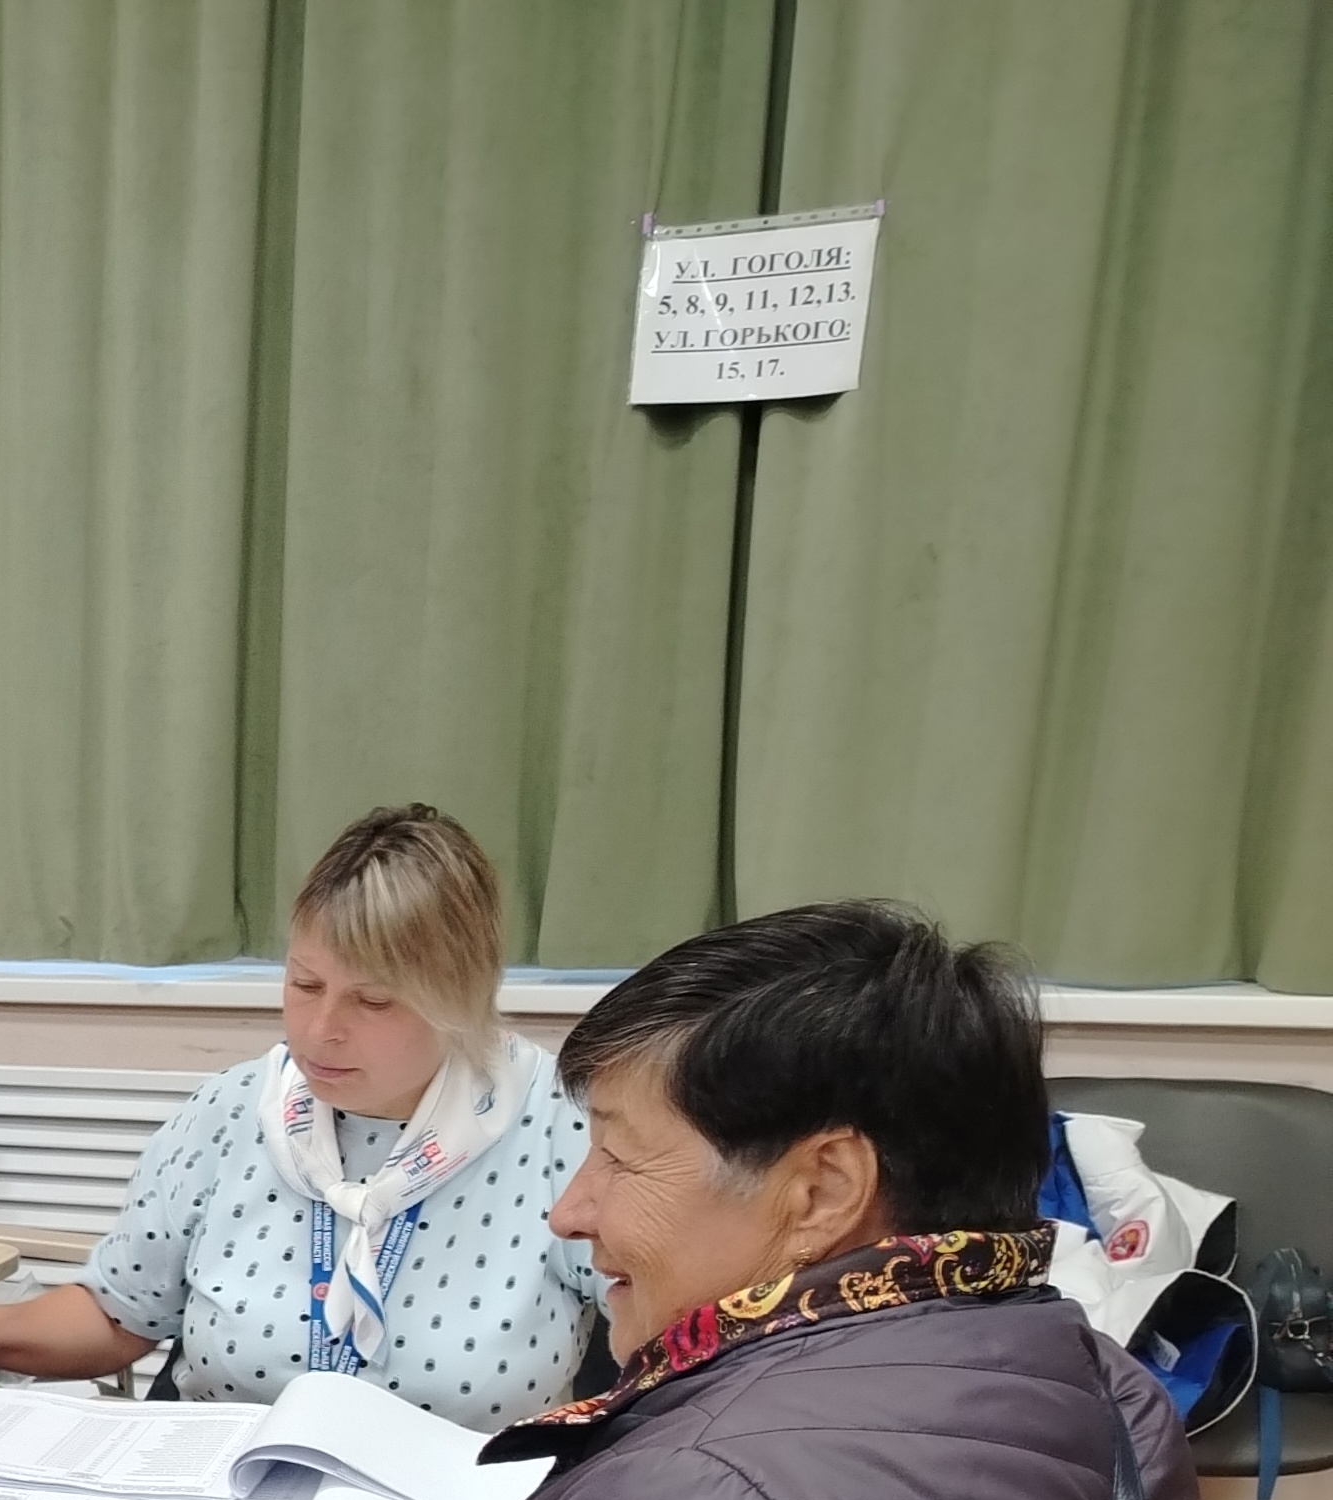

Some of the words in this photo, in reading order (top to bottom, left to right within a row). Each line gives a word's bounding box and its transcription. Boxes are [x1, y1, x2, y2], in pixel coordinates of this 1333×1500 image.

[675, 260, 715, 279] УЛ.
[732, 246, 851, 275] ГОГОЛЯ:
[658, 295, 677, 316] 5,
[686, 295, 705, 315] 8,
[715, 292, 735, 314] 9,
[745, 289, 778, 312] 11,
[654, 330, 694, 349] УЛ.
[703, 319, 851, 347] ГОРЬКОГО:
[716, 361, 745, 381] 15,
[755, 358, 785, 379] 17.
